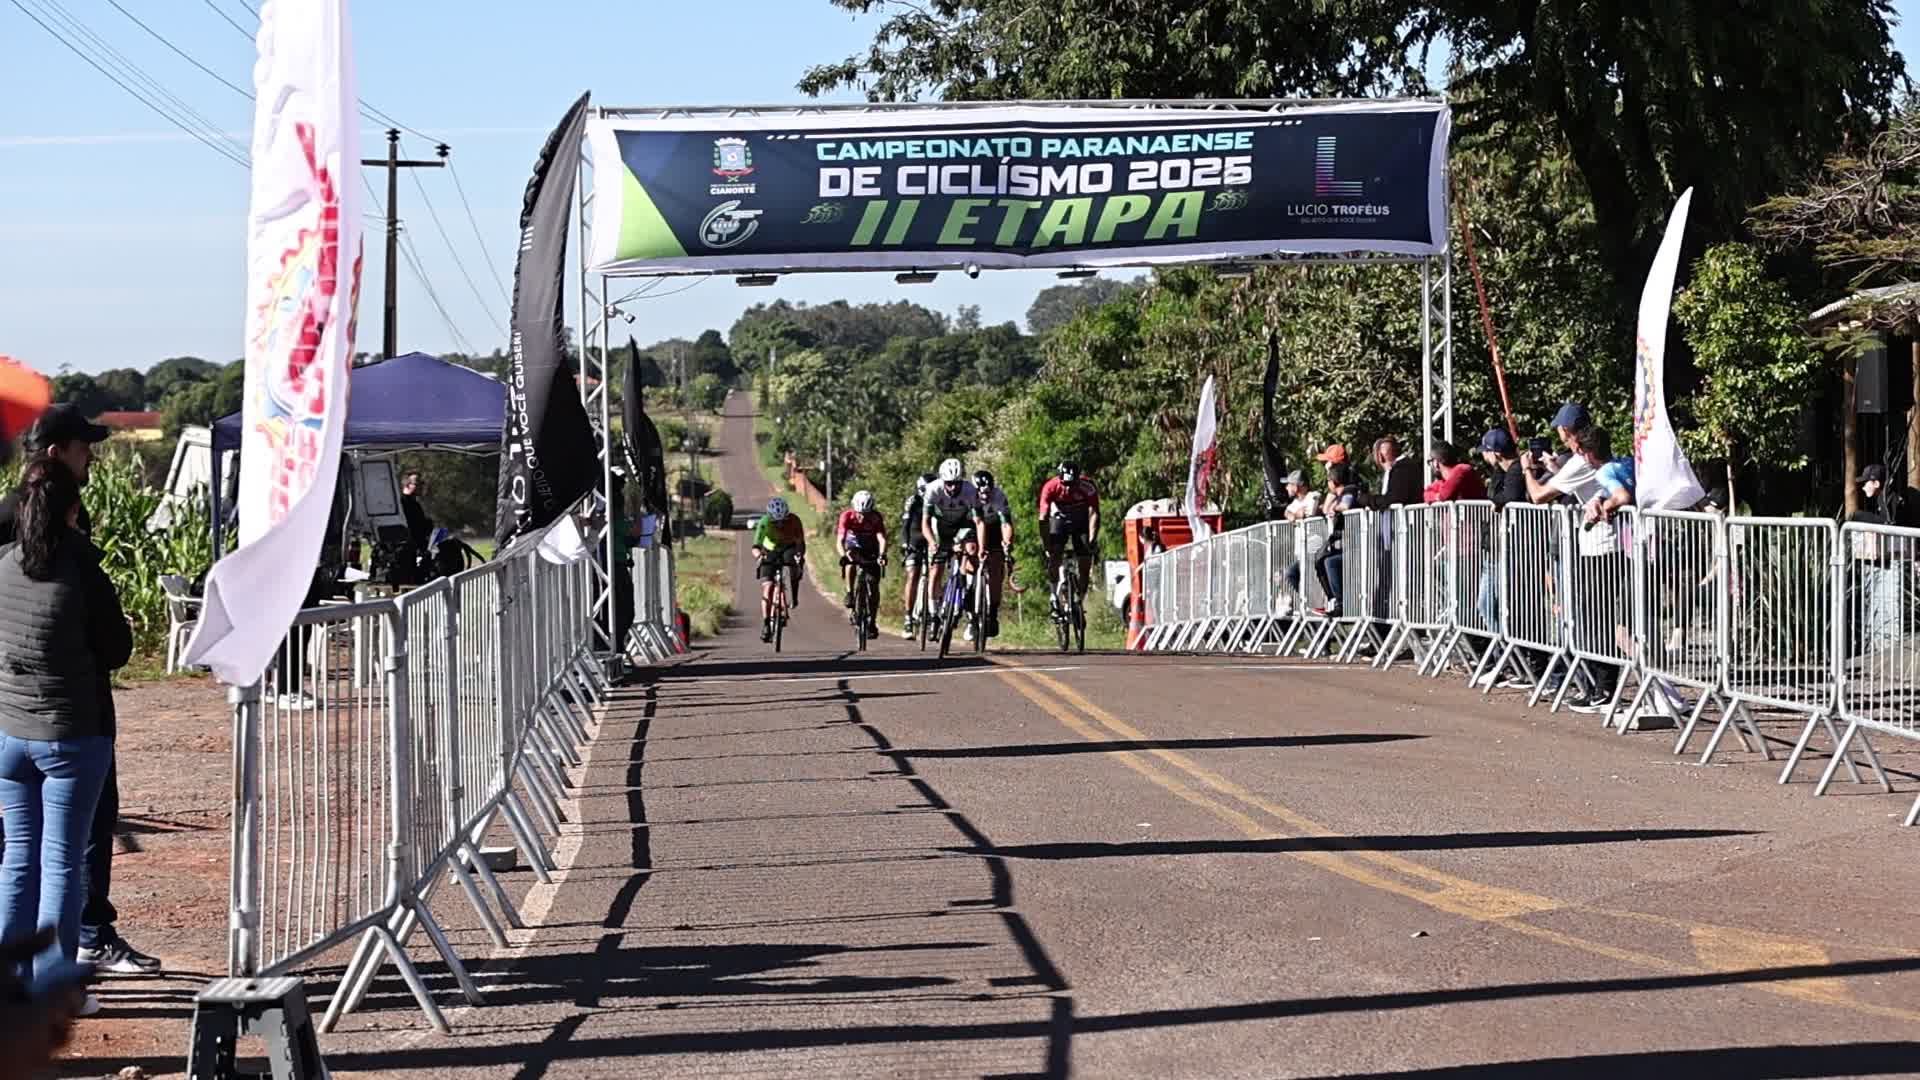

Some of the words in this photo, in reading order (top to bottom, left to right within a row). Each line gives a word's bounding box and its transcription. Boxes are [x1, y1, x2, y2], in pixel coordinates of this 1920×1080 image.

[816, 137, 1032, 161] CAMPEONATO
[1041, 131, 1254, 158] PARANAENSE
[710, 186, 756, 195] CIANORTE
[819, 166, 882, 197] DE
[897, 156, 1113, 196] CICLÍSMO
[850, 199, 920, 245] II
[936, 190, 1205, 248] ETAPA
[1287, 204, 1328, 216] LUCIO
[1331, 202, 1391, 215] TROFÉUS
[516, 392, 530, 435] VOCÊ
[523, 437, 539, 470] QUE
